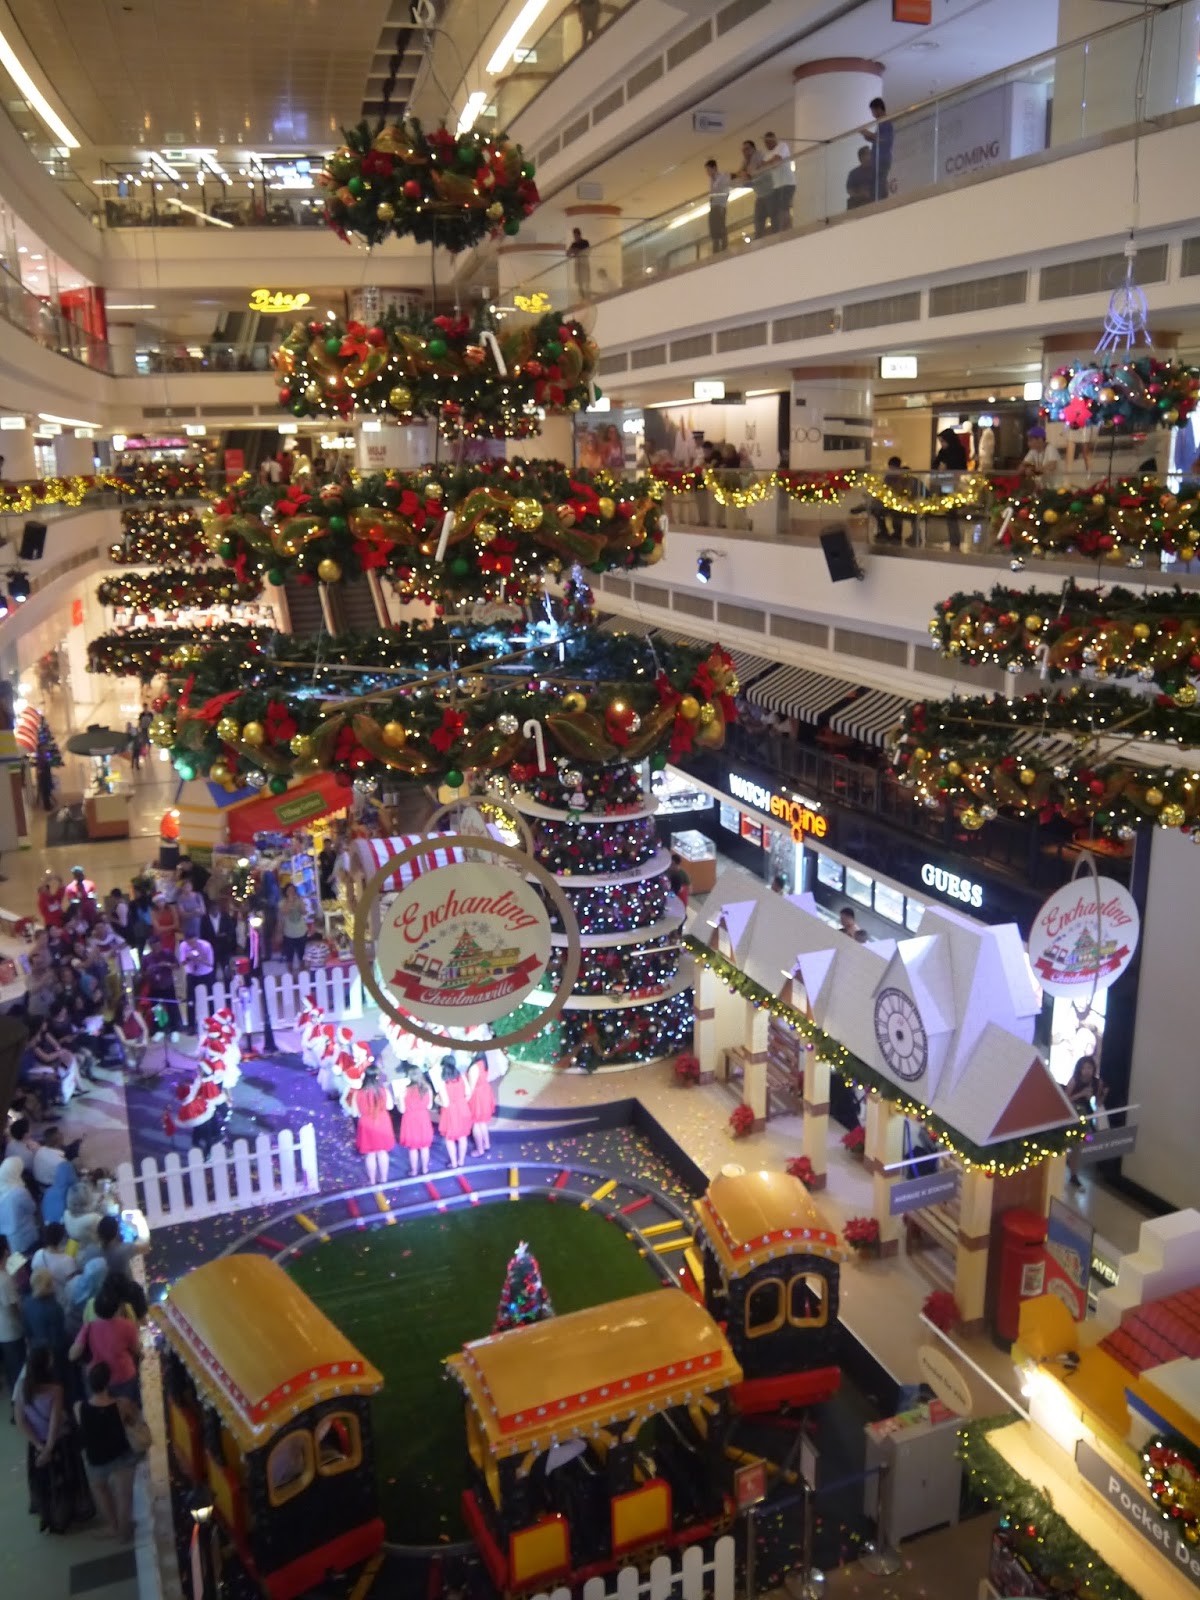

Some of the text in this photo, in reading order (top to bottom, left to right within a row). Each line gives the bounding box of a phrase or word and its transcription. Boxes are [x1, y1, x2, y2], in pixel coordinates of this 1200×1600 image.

[945, 141, 1000, 173] COMING
[921, 863, 983, 908] GUESS
[393, 889, 539, 943] Enchanting
[1041, 896, 1132, 938] Enchanting
[420, 981, 515, 1005] Christmasville
[1107, 1476, 1171, 1549] Pocket
